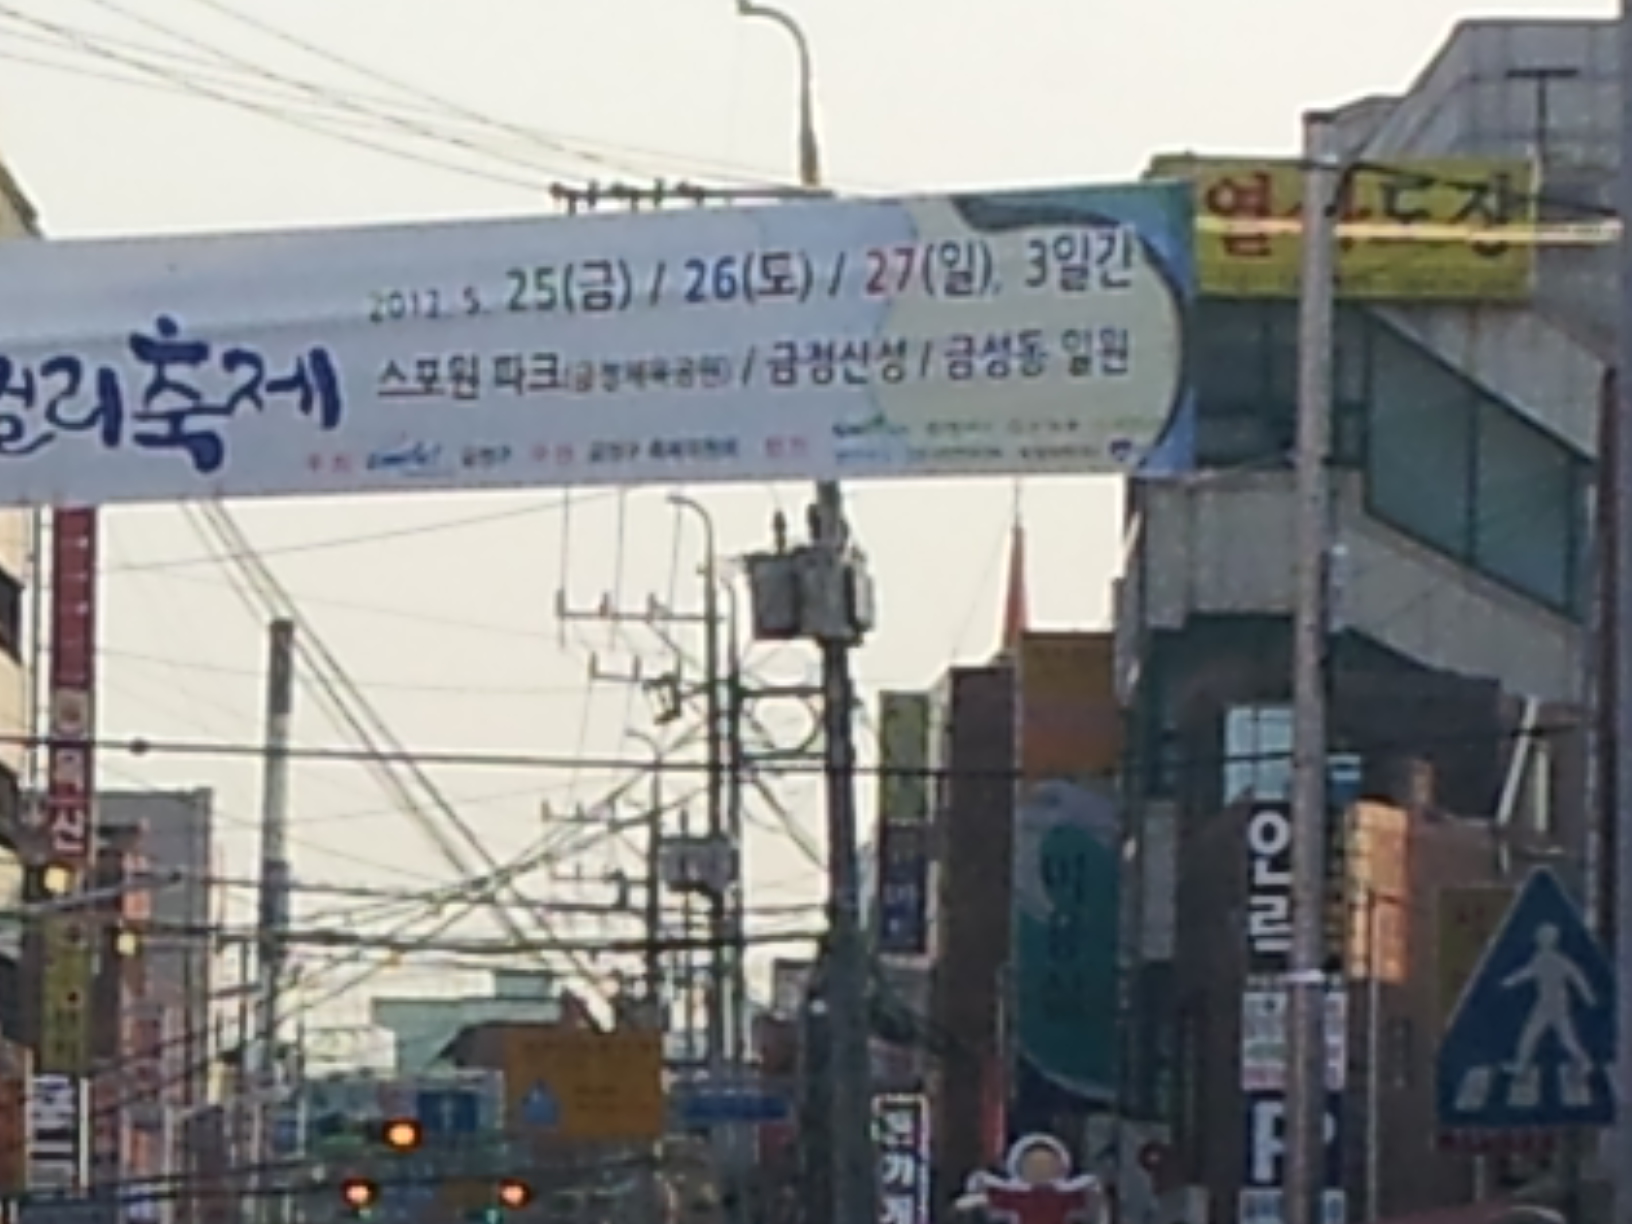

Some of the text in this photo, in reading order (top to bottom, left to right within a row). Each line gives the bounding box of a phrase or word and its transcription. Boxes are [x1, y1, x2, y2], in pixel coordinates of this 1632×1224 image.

[504, 258, 632, 315] 25(금)
[683, 249, 814, 306] 26(토)
[1023, 224, 1133, 291] 3일간
[377, 351, 481, 400] 스포원
[768, 336, 909, 387] 금정산성
[943, 328, 1047, 381] 금성동
[1061, 327, 1131, 378] 일원
